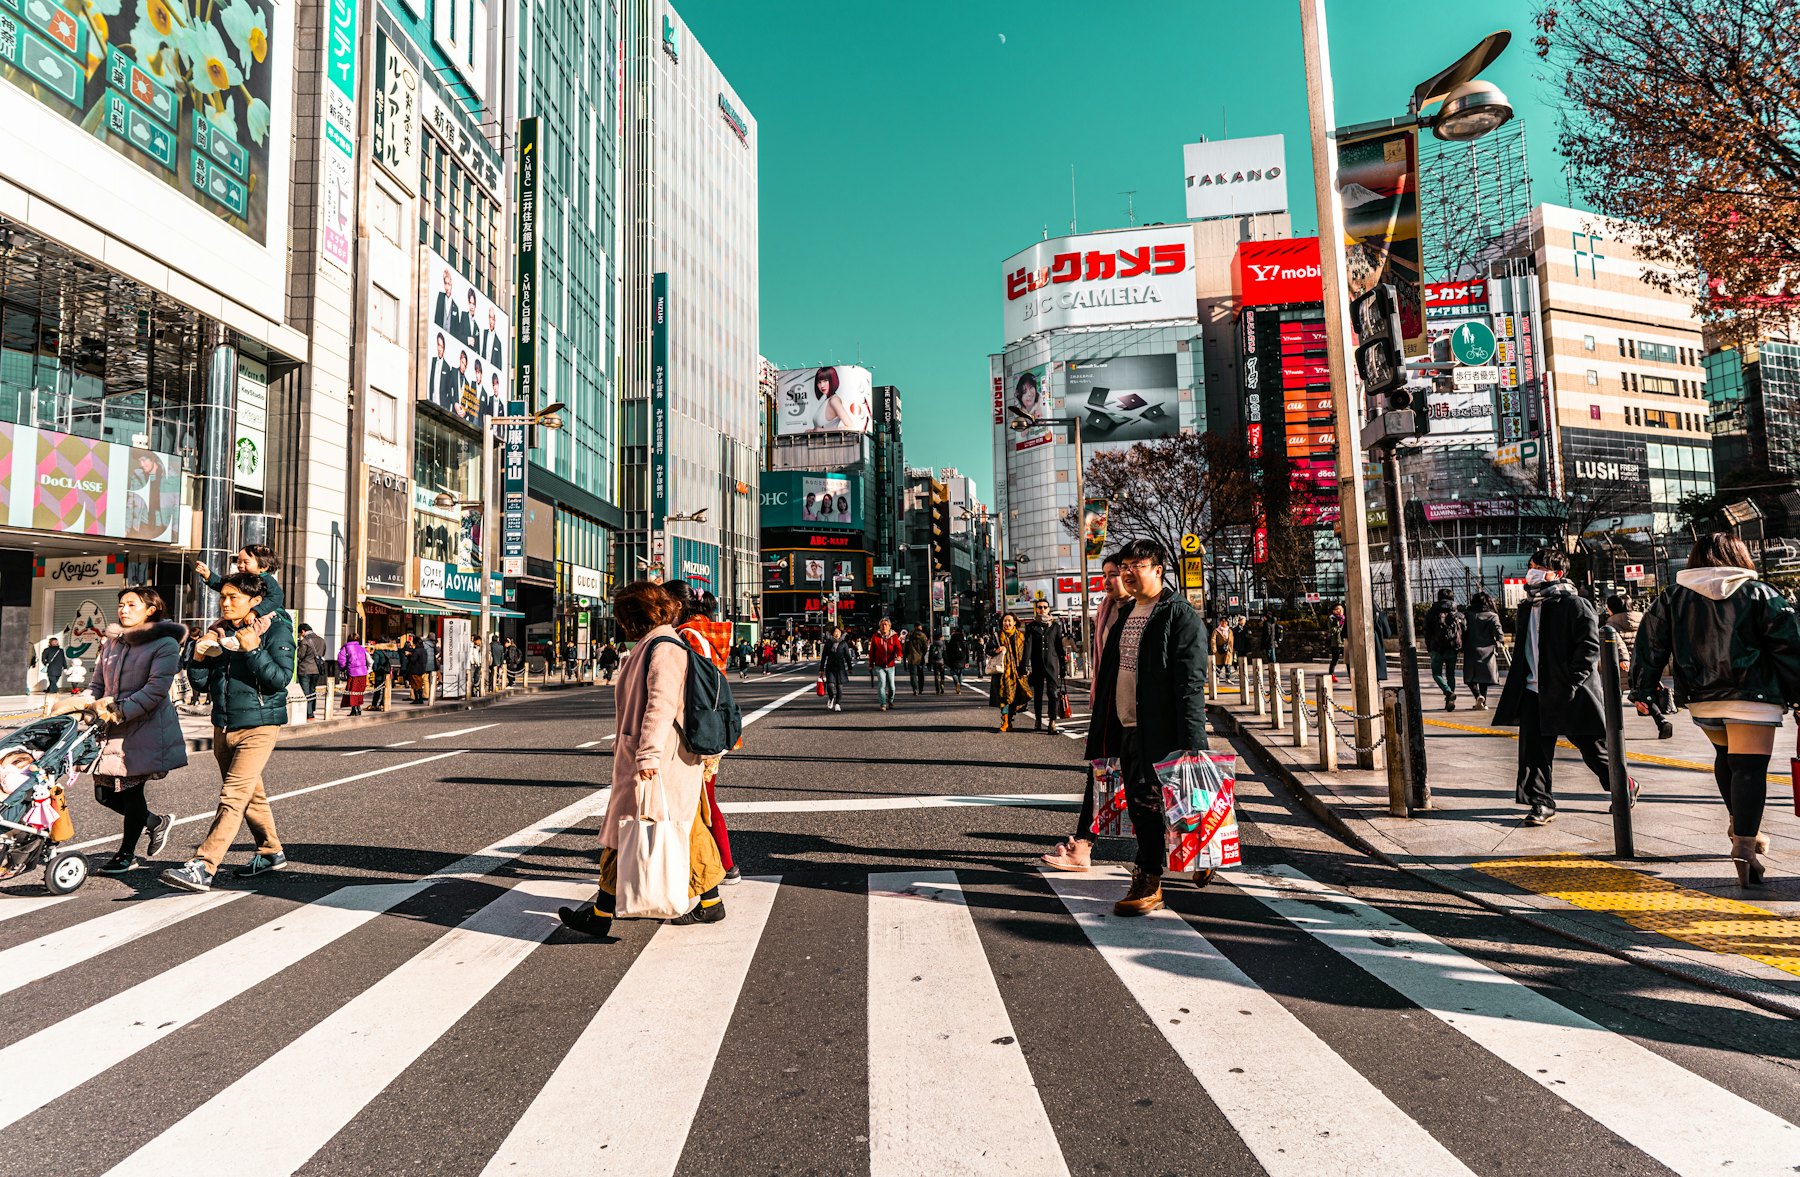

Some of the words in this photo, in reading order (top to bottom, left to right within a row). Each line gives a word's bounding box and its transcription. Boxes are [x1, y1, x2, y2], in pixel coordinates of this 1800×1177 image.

[0, 15, 16, 62] 神奈川
[113, 52, 126, 89] 千葉
[111, 98, 125, 133] 山梨
[388, 56, 401, 167] ルノアール
[196, 116, 208, 149] 静岡
[194, 157, 207, 188] 長野
[524, 156, 532, 187] SMBC
[1185, 166, 1281, 188] TAKANO
[522, 190, 533, 252] 三井住友銀行
[1007, 243, 1186, 301] ビックカメラ
[1023, 295, 1053, 321] BIC
[1056, 283, 1163, 312] CAMERA
[1455, 371, 1497, 382] 歩行者優先
[786, 390, 807, 403] Spa
[994, 377, 1003, 425] ビックカメラ
[1287, 402, 1304, 410] au
[1288, 436, 1306, 444] au
[1520, 442, 1538, 469] P
[1575, 461, 1620, 480] LUSH
[1620, 464, 1639, 472] FRESH
[40, 473, 103, 493] DoCLASSE
[373, 473, 408, 494] AOKI
[1610, 517, 1621, 529] P
[810, 535, 849, 546] ABC-MART
[1186, 536, 1196, 549] 2
[52, 561, 99, 581] Konjac
[388, 574, 403, 582] AOKI
[683, 560, 710, 576] MIZUHO
[421, 579, 443, 590] ルノアール
[577, 574, 597, 589] GUCCI
